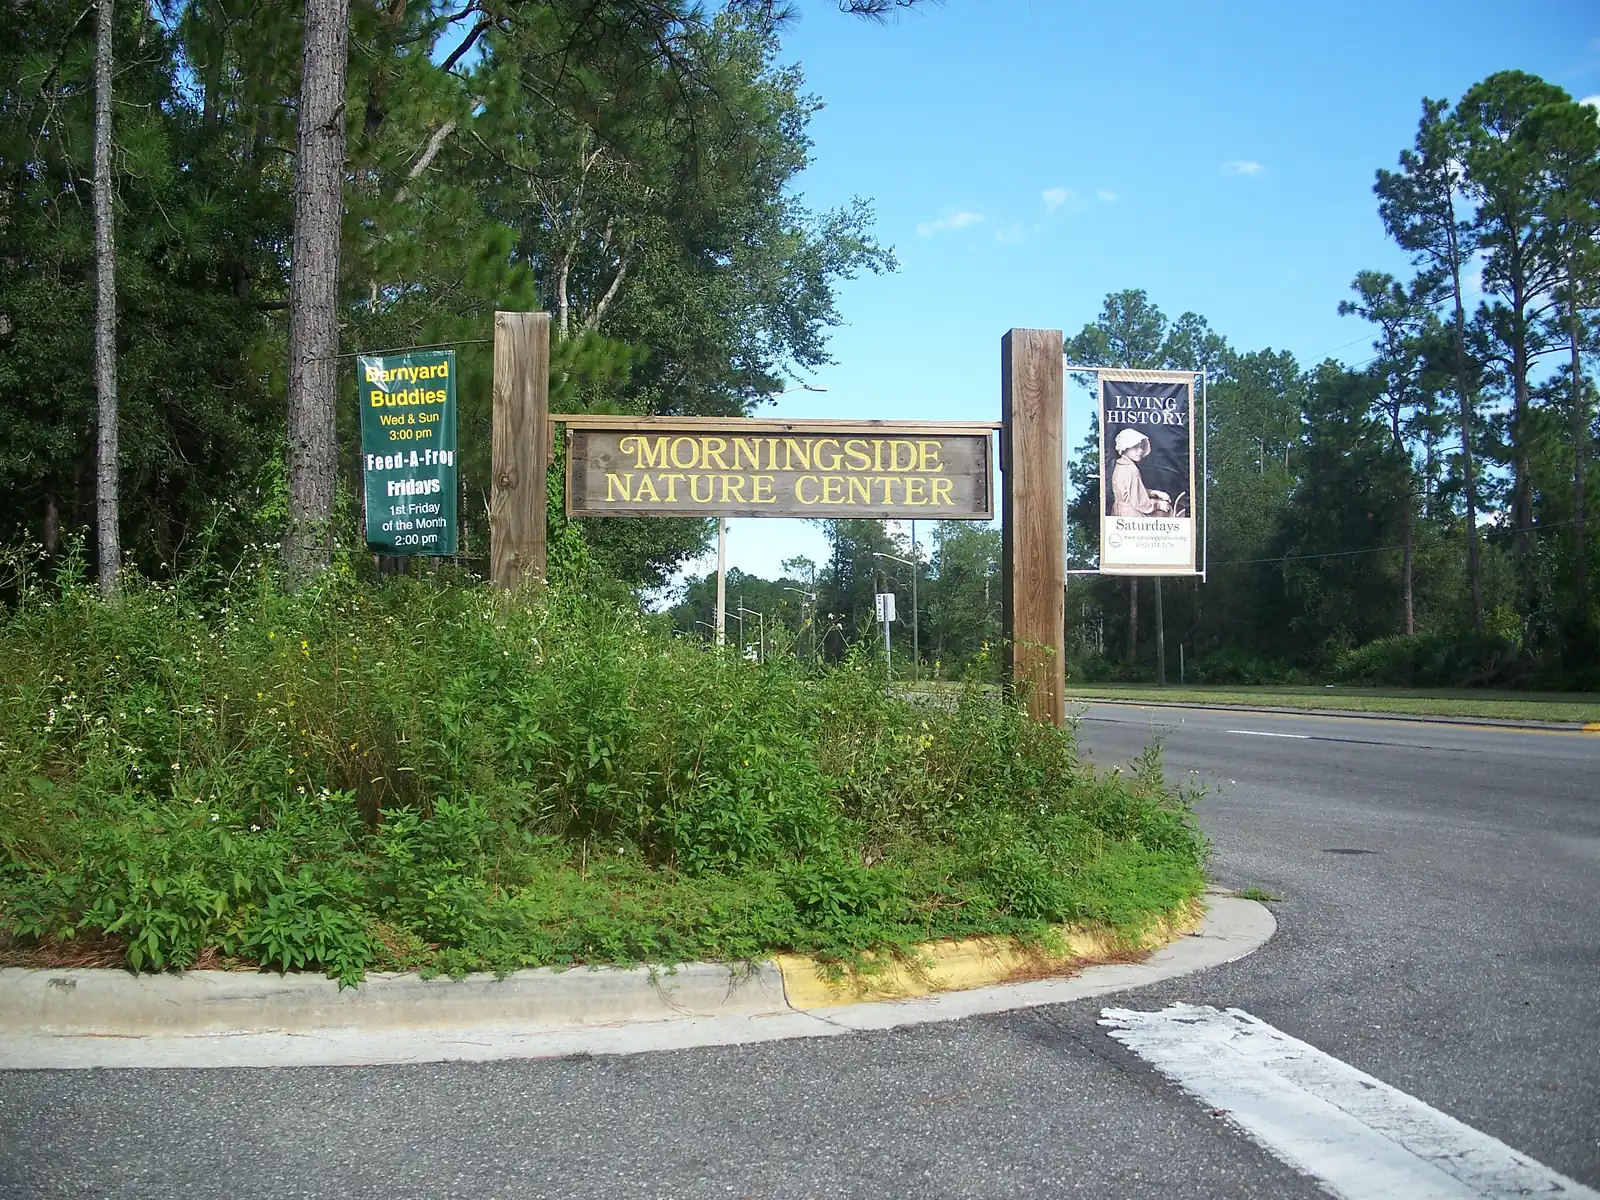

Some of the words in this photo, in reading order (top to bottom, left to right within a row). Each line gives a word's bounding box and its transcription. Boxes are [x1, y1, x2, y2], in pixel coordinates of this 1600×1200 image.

[366, 361, 449, 383] Barnyard
[370, 388, 447, 407] Buddies
[1114, 395, 1178, 412] LIVING
[379, 414, 405, 425] Wed
[407, 413, 416, 425] &
[418, 412, 440, 424] Sun
[1106, 410, 1186, 426] HISTORY
[389, 429, 414, 441] 3:00
[415, 429, 433, 441] pm
[619, 436, 944, 473] MORNINGSIDE
[387, 478, 441, 497] Fridays
[604, 472, 777, 503] NATURE
[795, 476, 956, 506] CENTER
[389, 504, 406, 516] 1st
[408, 502, 441, 516] Friday
[382, 520, 395, 532] of
[395, 519, 413, 531] the
[415, 516, 447, 530] Month
[1116, 518, 1180, 534] Saturdays
[394, 534, 419, 547] 2:00
[421, 533, 438, 547] pm
